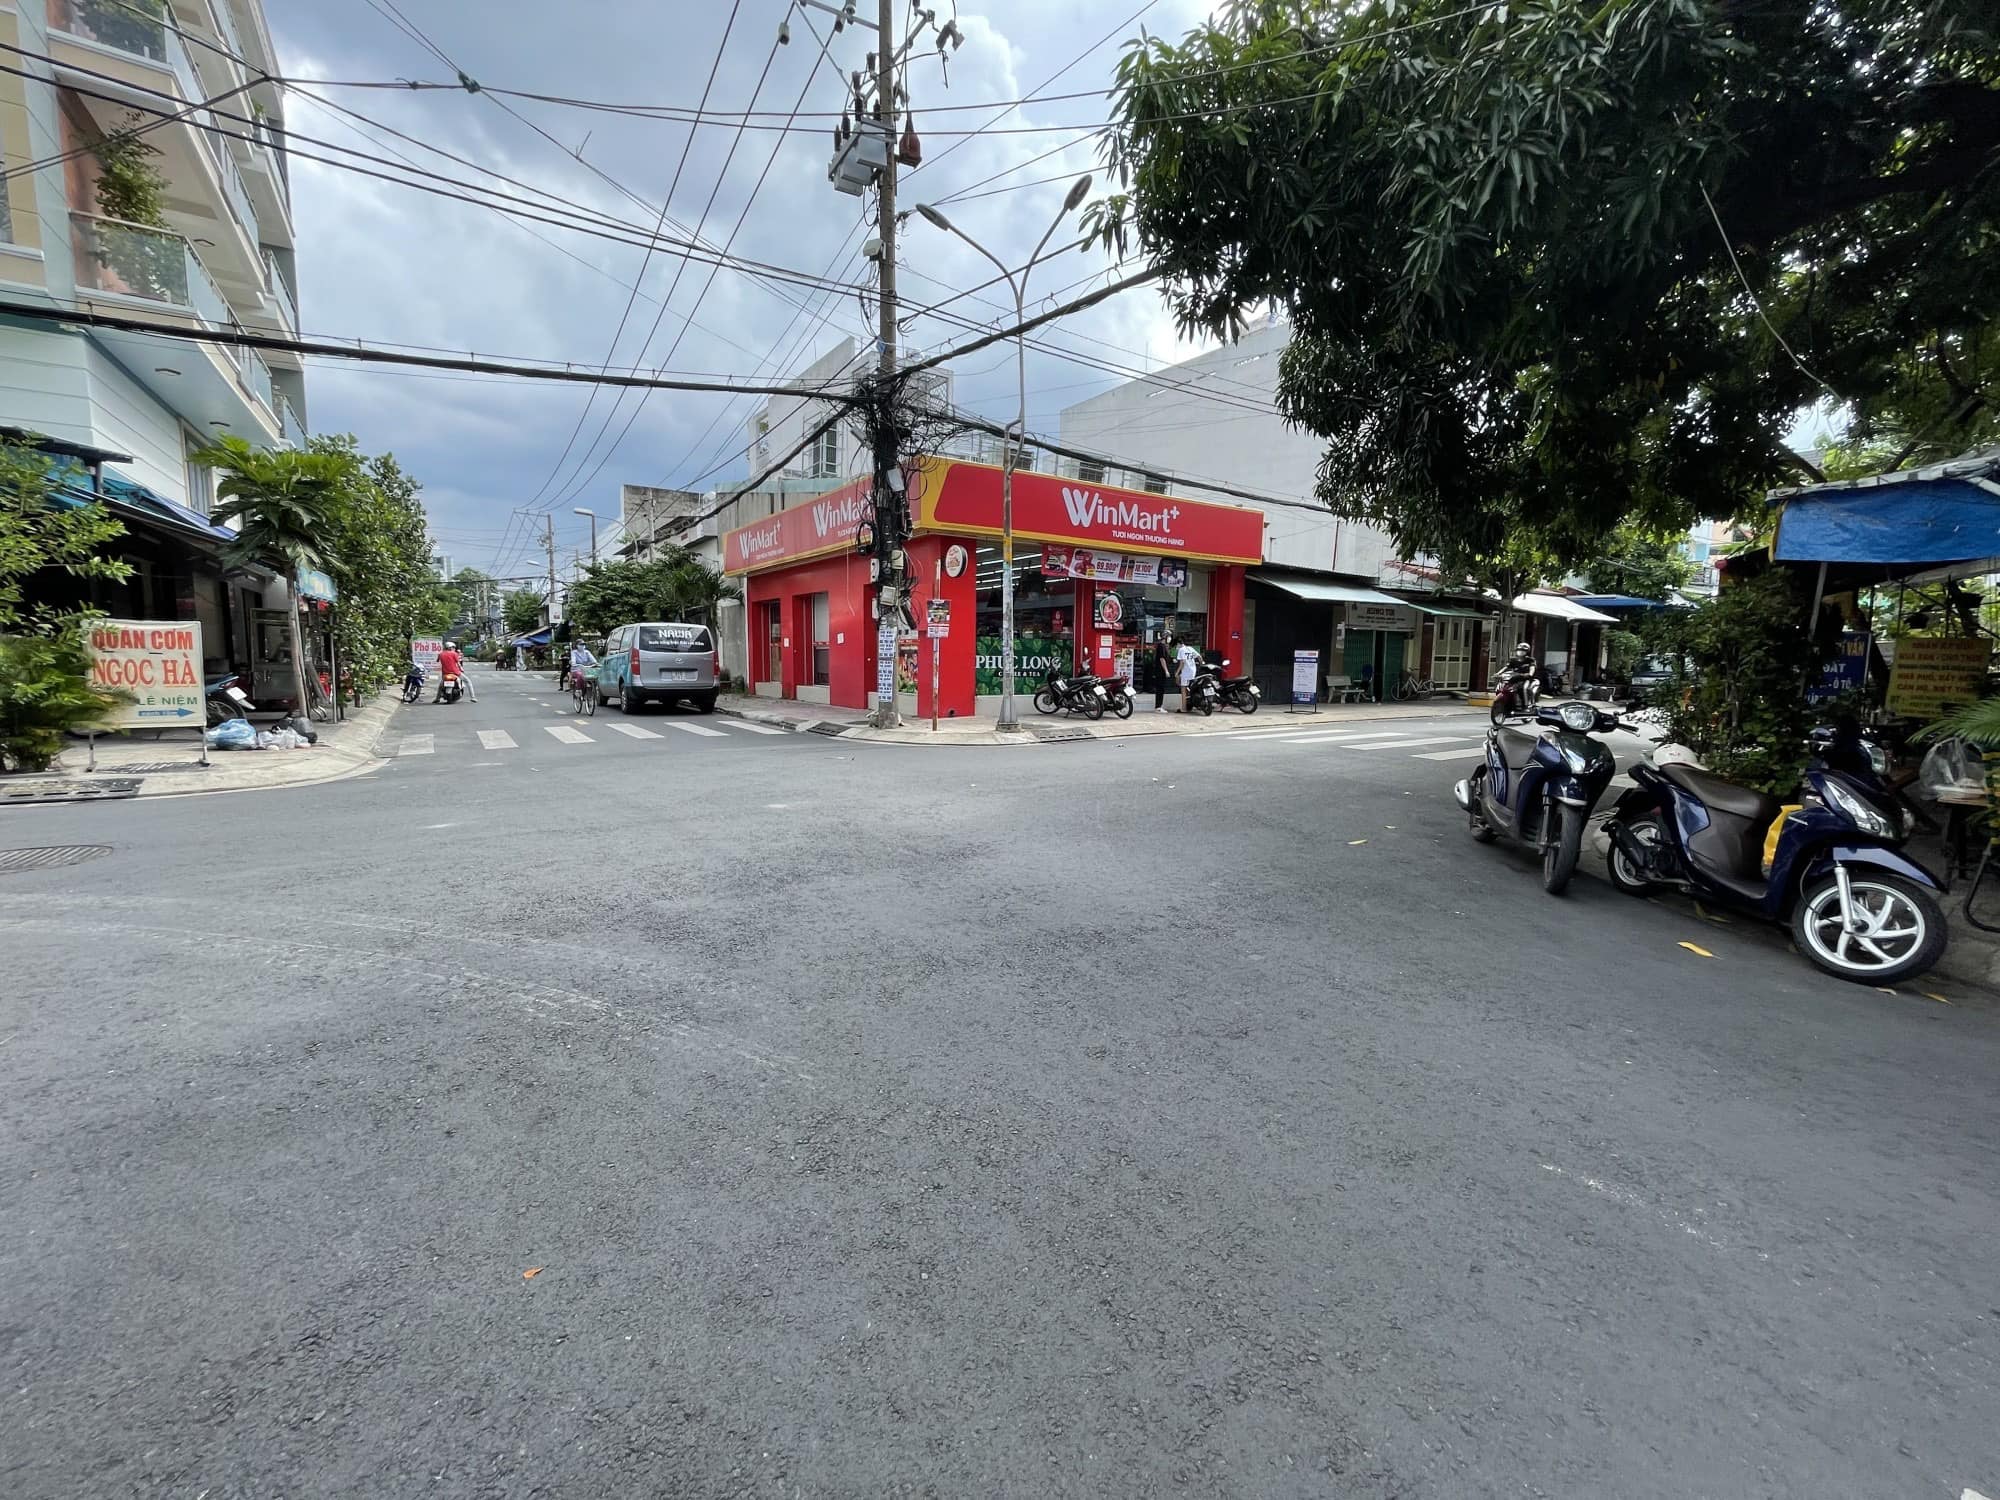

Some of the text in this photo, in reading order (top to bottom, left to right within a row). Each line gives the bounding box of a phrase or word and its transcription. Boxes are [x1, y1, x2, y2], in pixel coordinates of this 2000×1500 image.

[151, 628, 193, 650] CƠM
[92, 651, 197, 691] NGỌC HÀ
[1022, 655, 1061, 669] LONG
